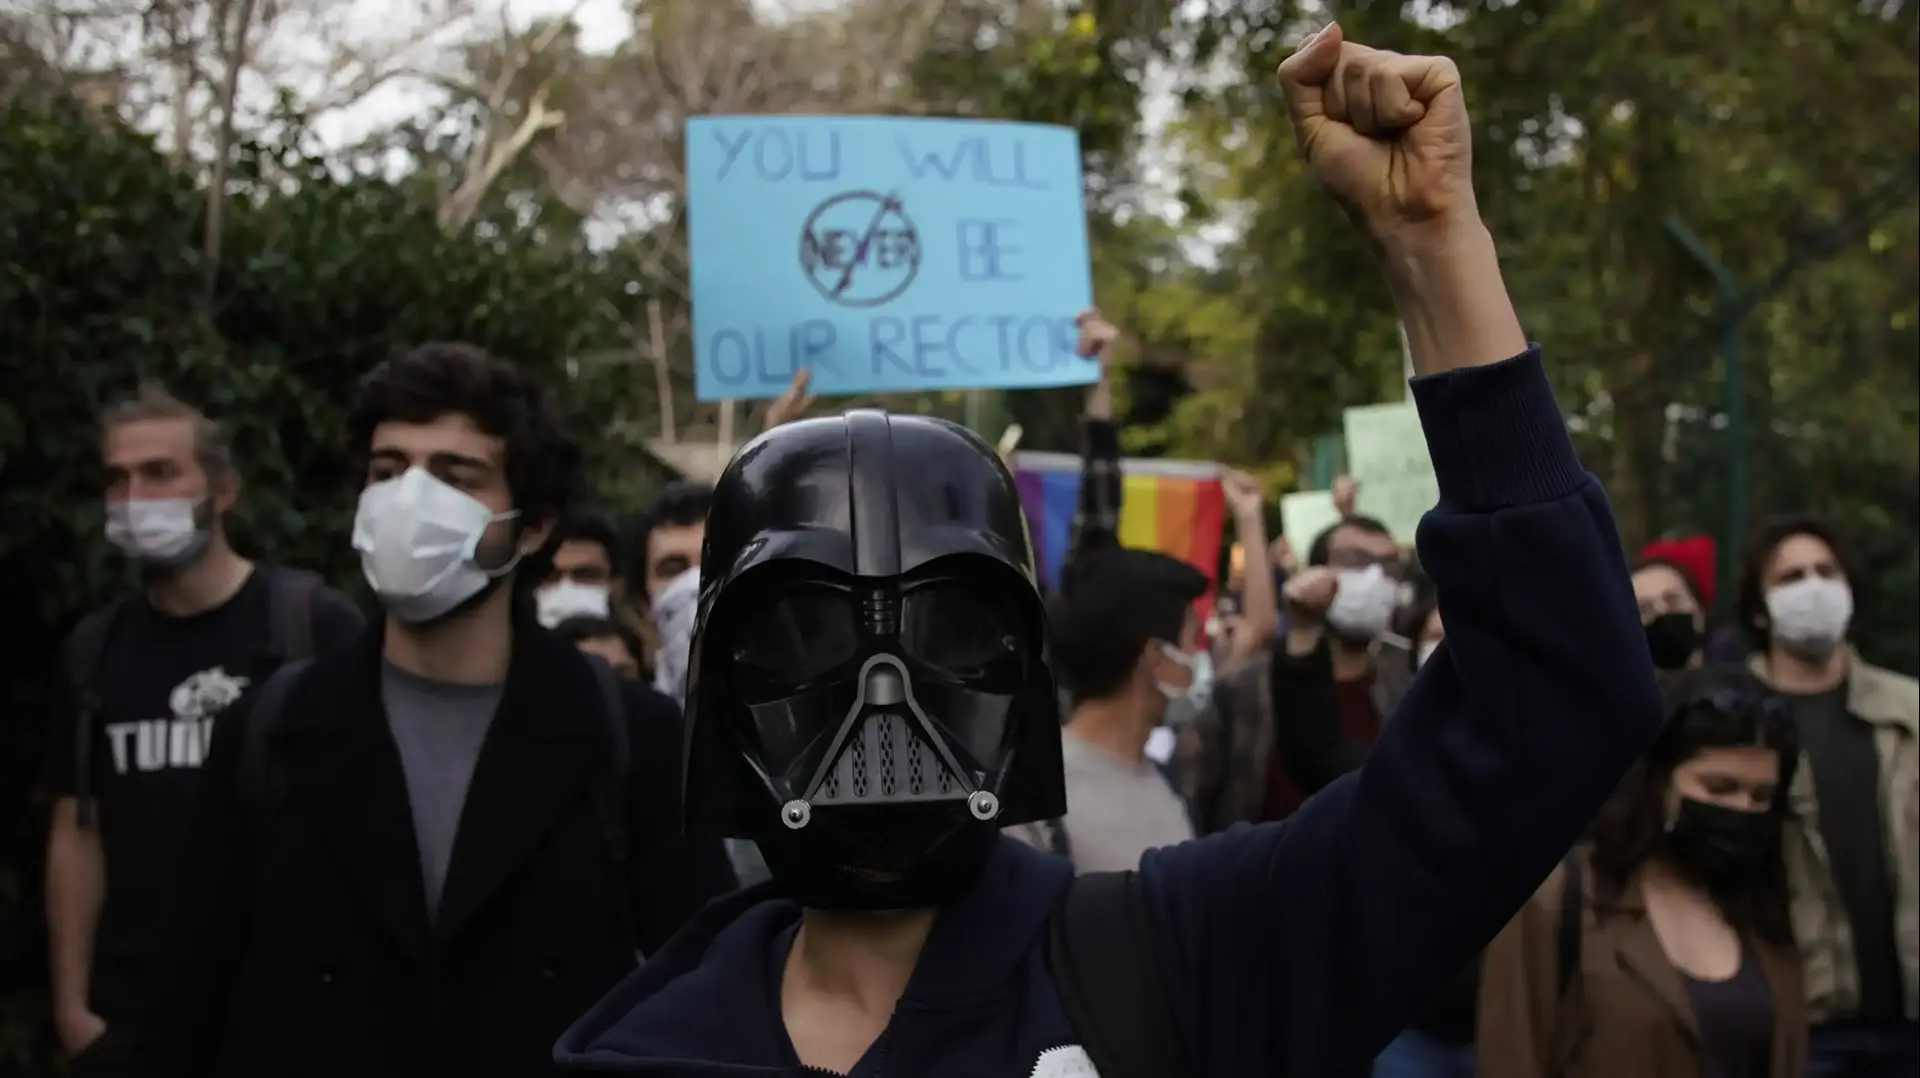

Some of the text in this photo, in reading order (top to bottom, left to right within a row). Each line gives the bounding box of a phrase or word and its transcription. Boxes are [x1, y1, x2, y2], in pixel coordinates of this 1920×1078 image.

[713, 127, 1049, 188] YOU WILL
[803, 219, 1025, 280] NEVER BE
[711, 320, 847, 385] OUR
